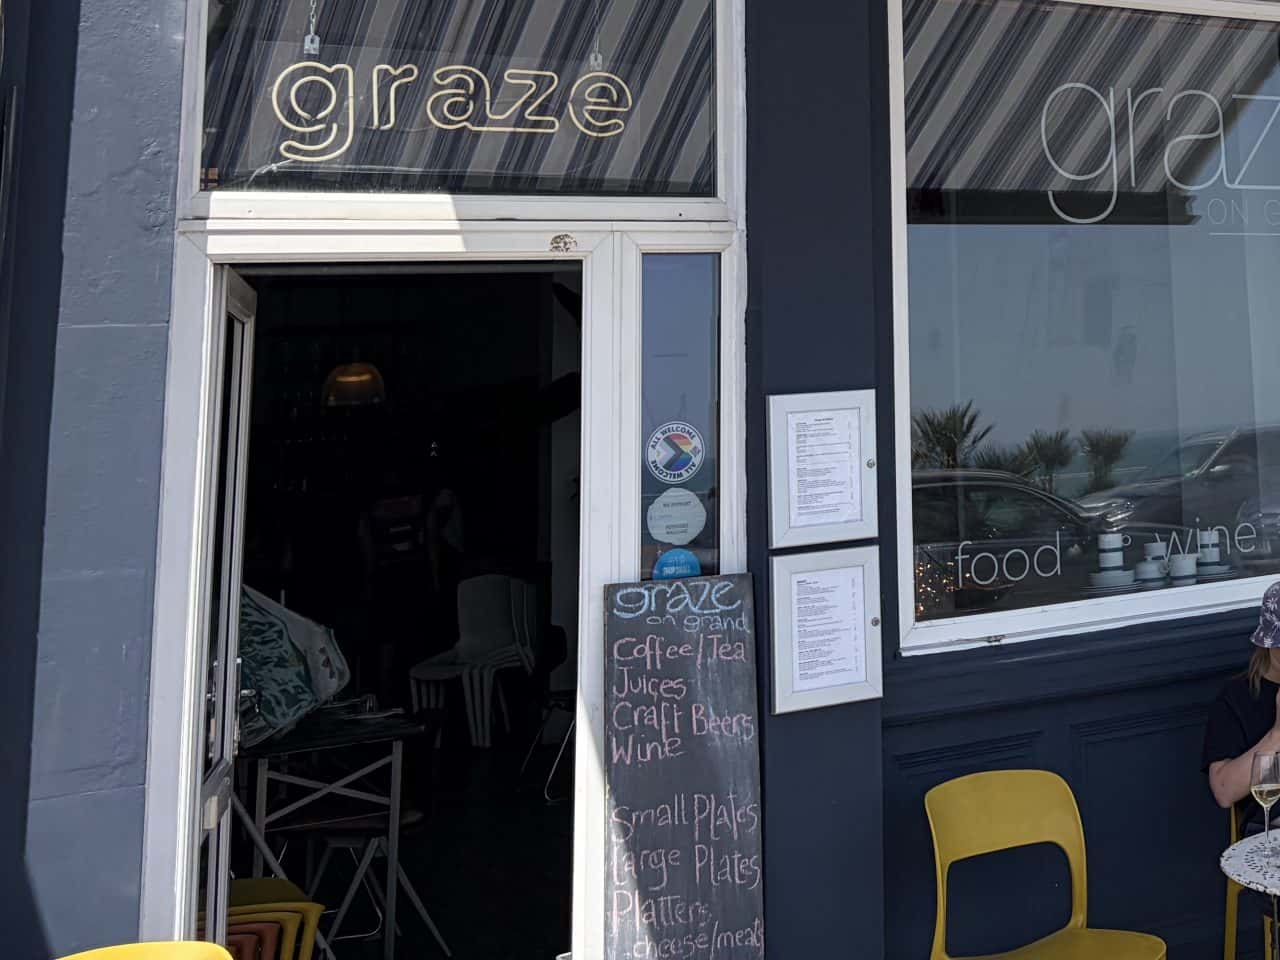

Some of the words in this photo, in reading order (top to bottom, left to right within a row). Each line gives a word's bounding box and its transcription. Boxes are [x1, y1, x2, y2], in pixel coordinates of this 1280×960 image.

[272, 61, 632, 162] graze
[1207, 198, 1250, 227] ON
[660, 426, 697, 440] WELCOME
[955, 530, 1062, 588] food
[1154, 516, 1257, 561] wine
[613, 581, 742, 619] graze
[646, 614, 676, 626] on
[683, 611, 750, 633] grand
[612, 666, 687, 701] Juices
[612, 701, 683, 742] Craft
[691, 703, 755, 740] Beers
[611, 733, 688, 766] Wine
[611, 793, 689, 841] Small
[693, 791, 759, 841] Plates
[612, 845, 682, 891] Large
[694, 844, 761, 890] Plates
